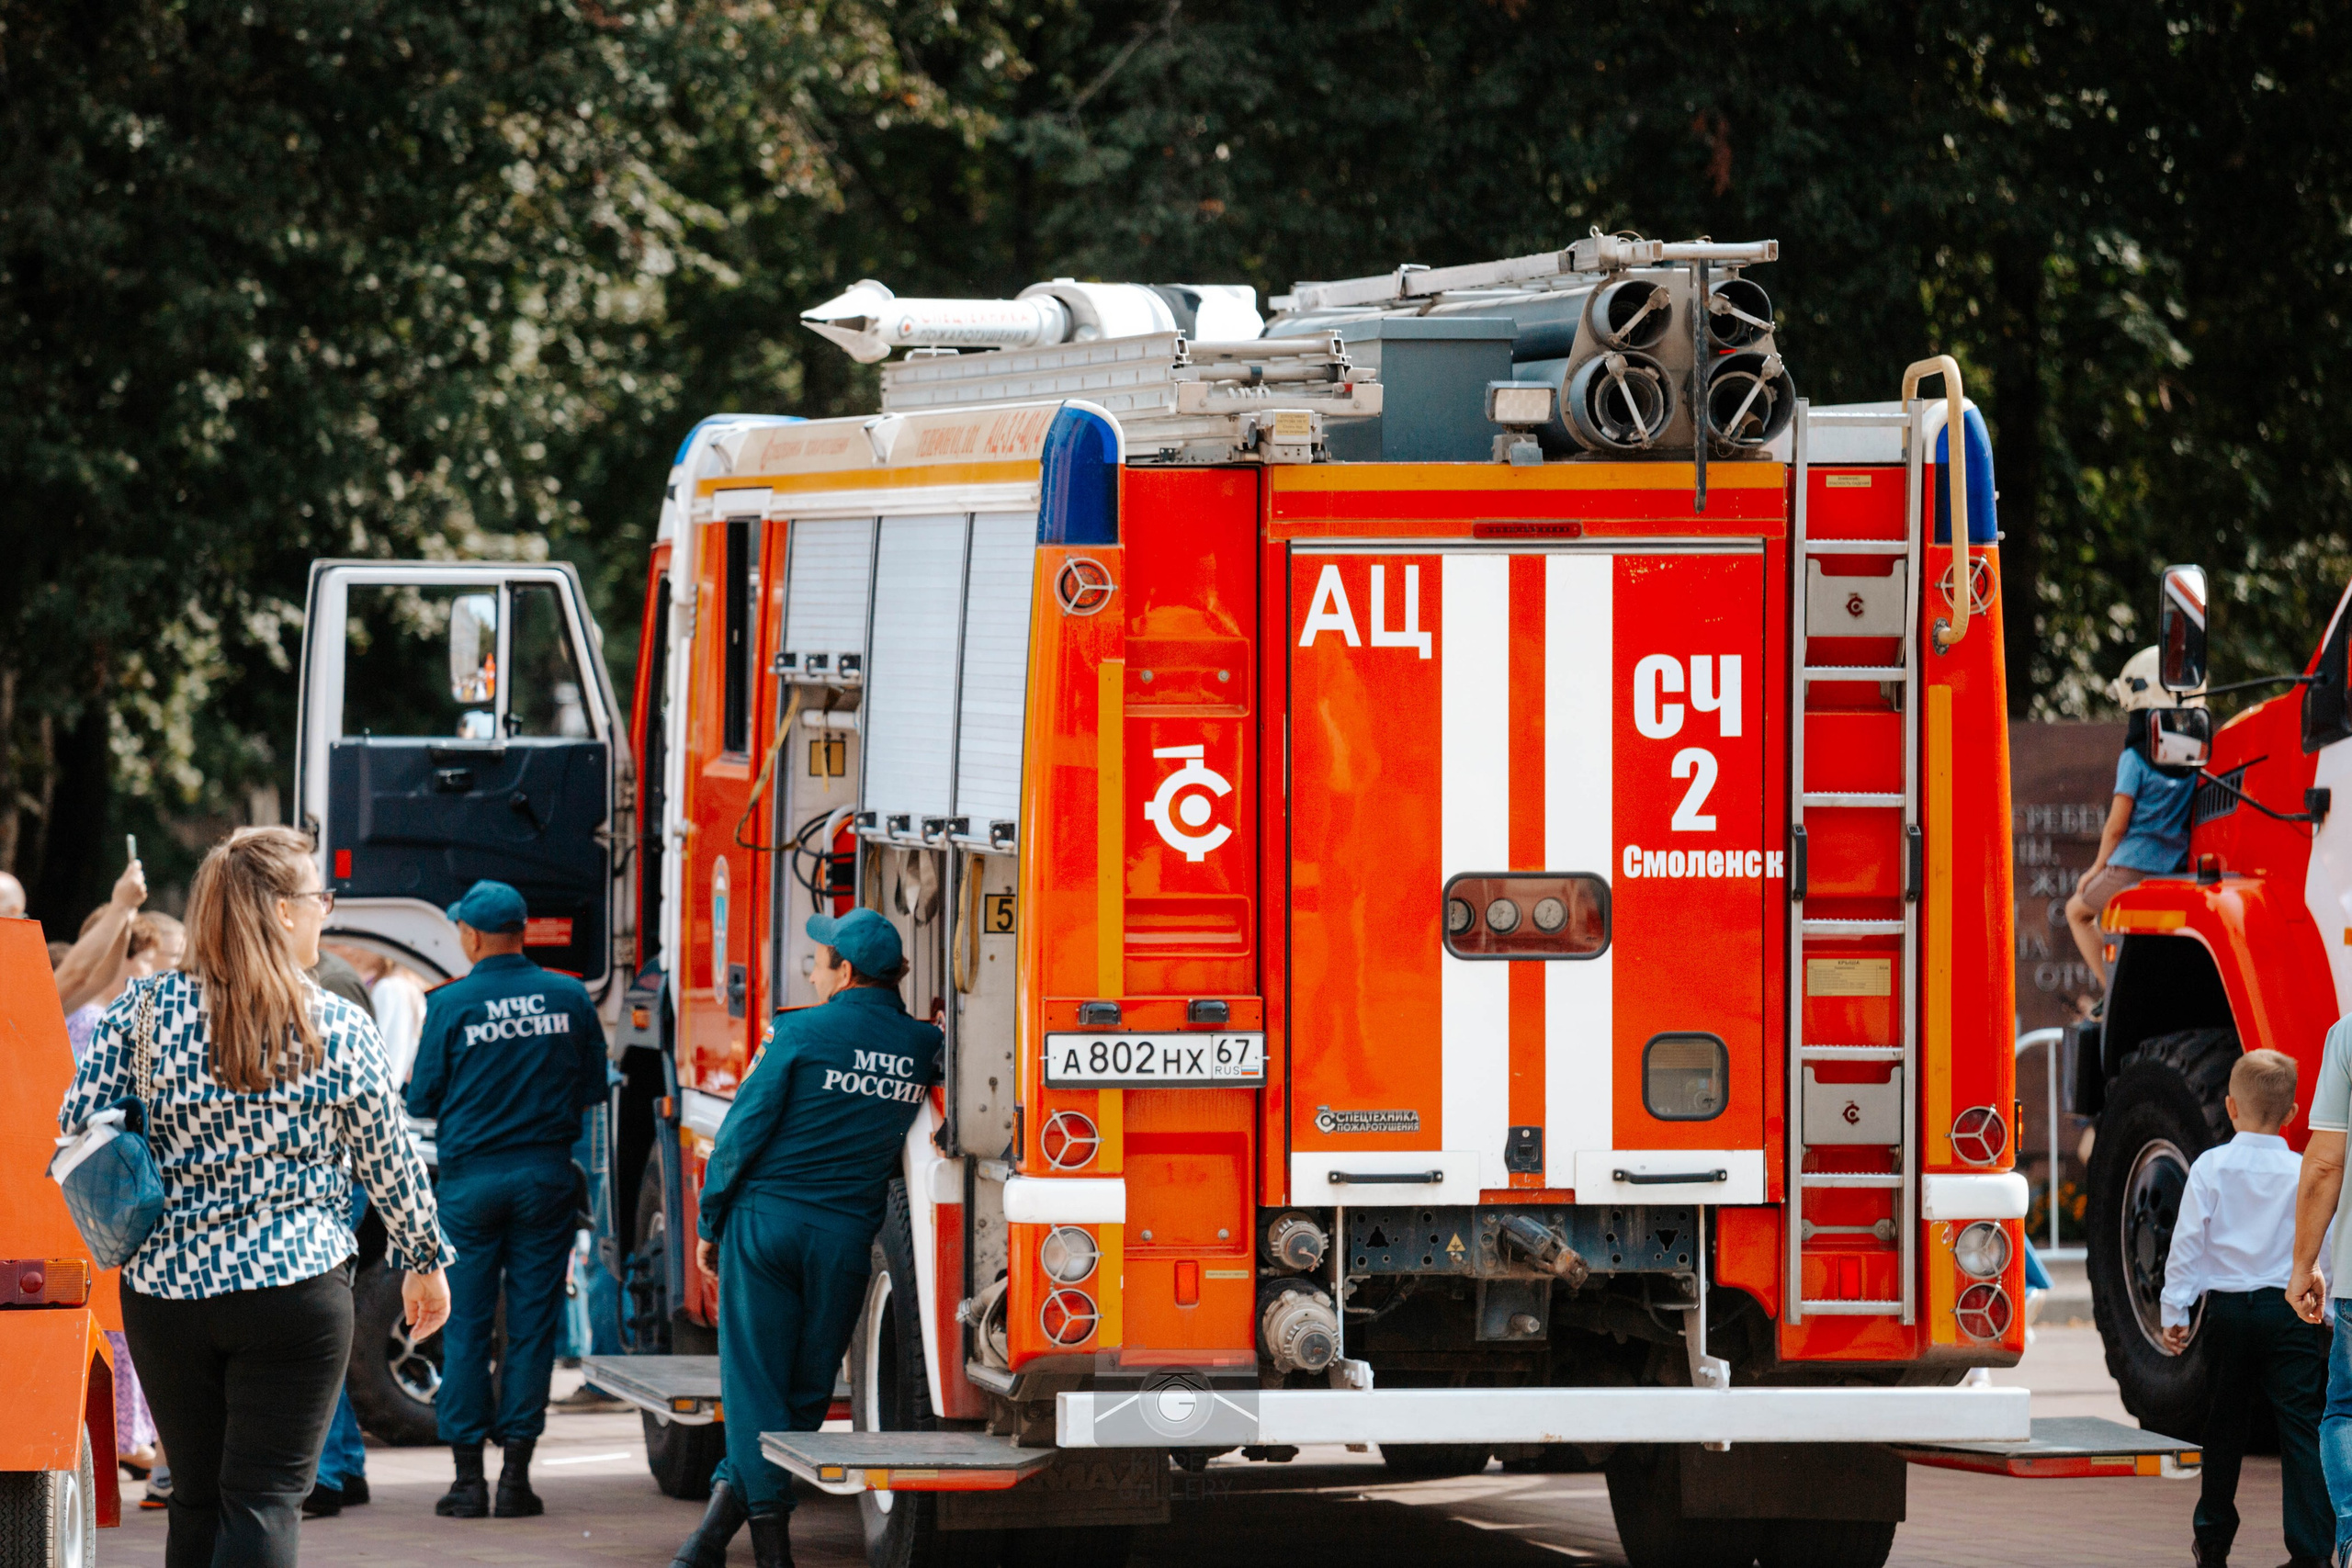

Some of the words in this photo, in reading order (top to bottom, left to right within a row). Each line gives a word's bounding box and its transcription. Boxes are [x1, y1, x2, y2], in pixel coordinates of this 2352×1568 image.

[1298, 564, 1431, 660] АЦ
[1634, 653, 1742, 739] СЧ
[1670, 747, 1718, 831] 2
[1623, 844, 1784, 879] Смоленск
[997, 898, 1013, 931] 5
[484, 994, 546, 1021] МЧС
[464, 1012, 570, 1046] РОССИИ
[853, 1049, 914, 1078] МЧС
[1216, 1039, 1250, 1065] 67
[822, 1068, 927, 1103] РОССИИ
[1215, 1066, 1239, 1076] RUS
[1336, 1110, 1419, 1122] СПЕЦТЕХНИКА
[1336, 1122, 1419, 1132] ПОЖАРОТУШЕНИЯ
